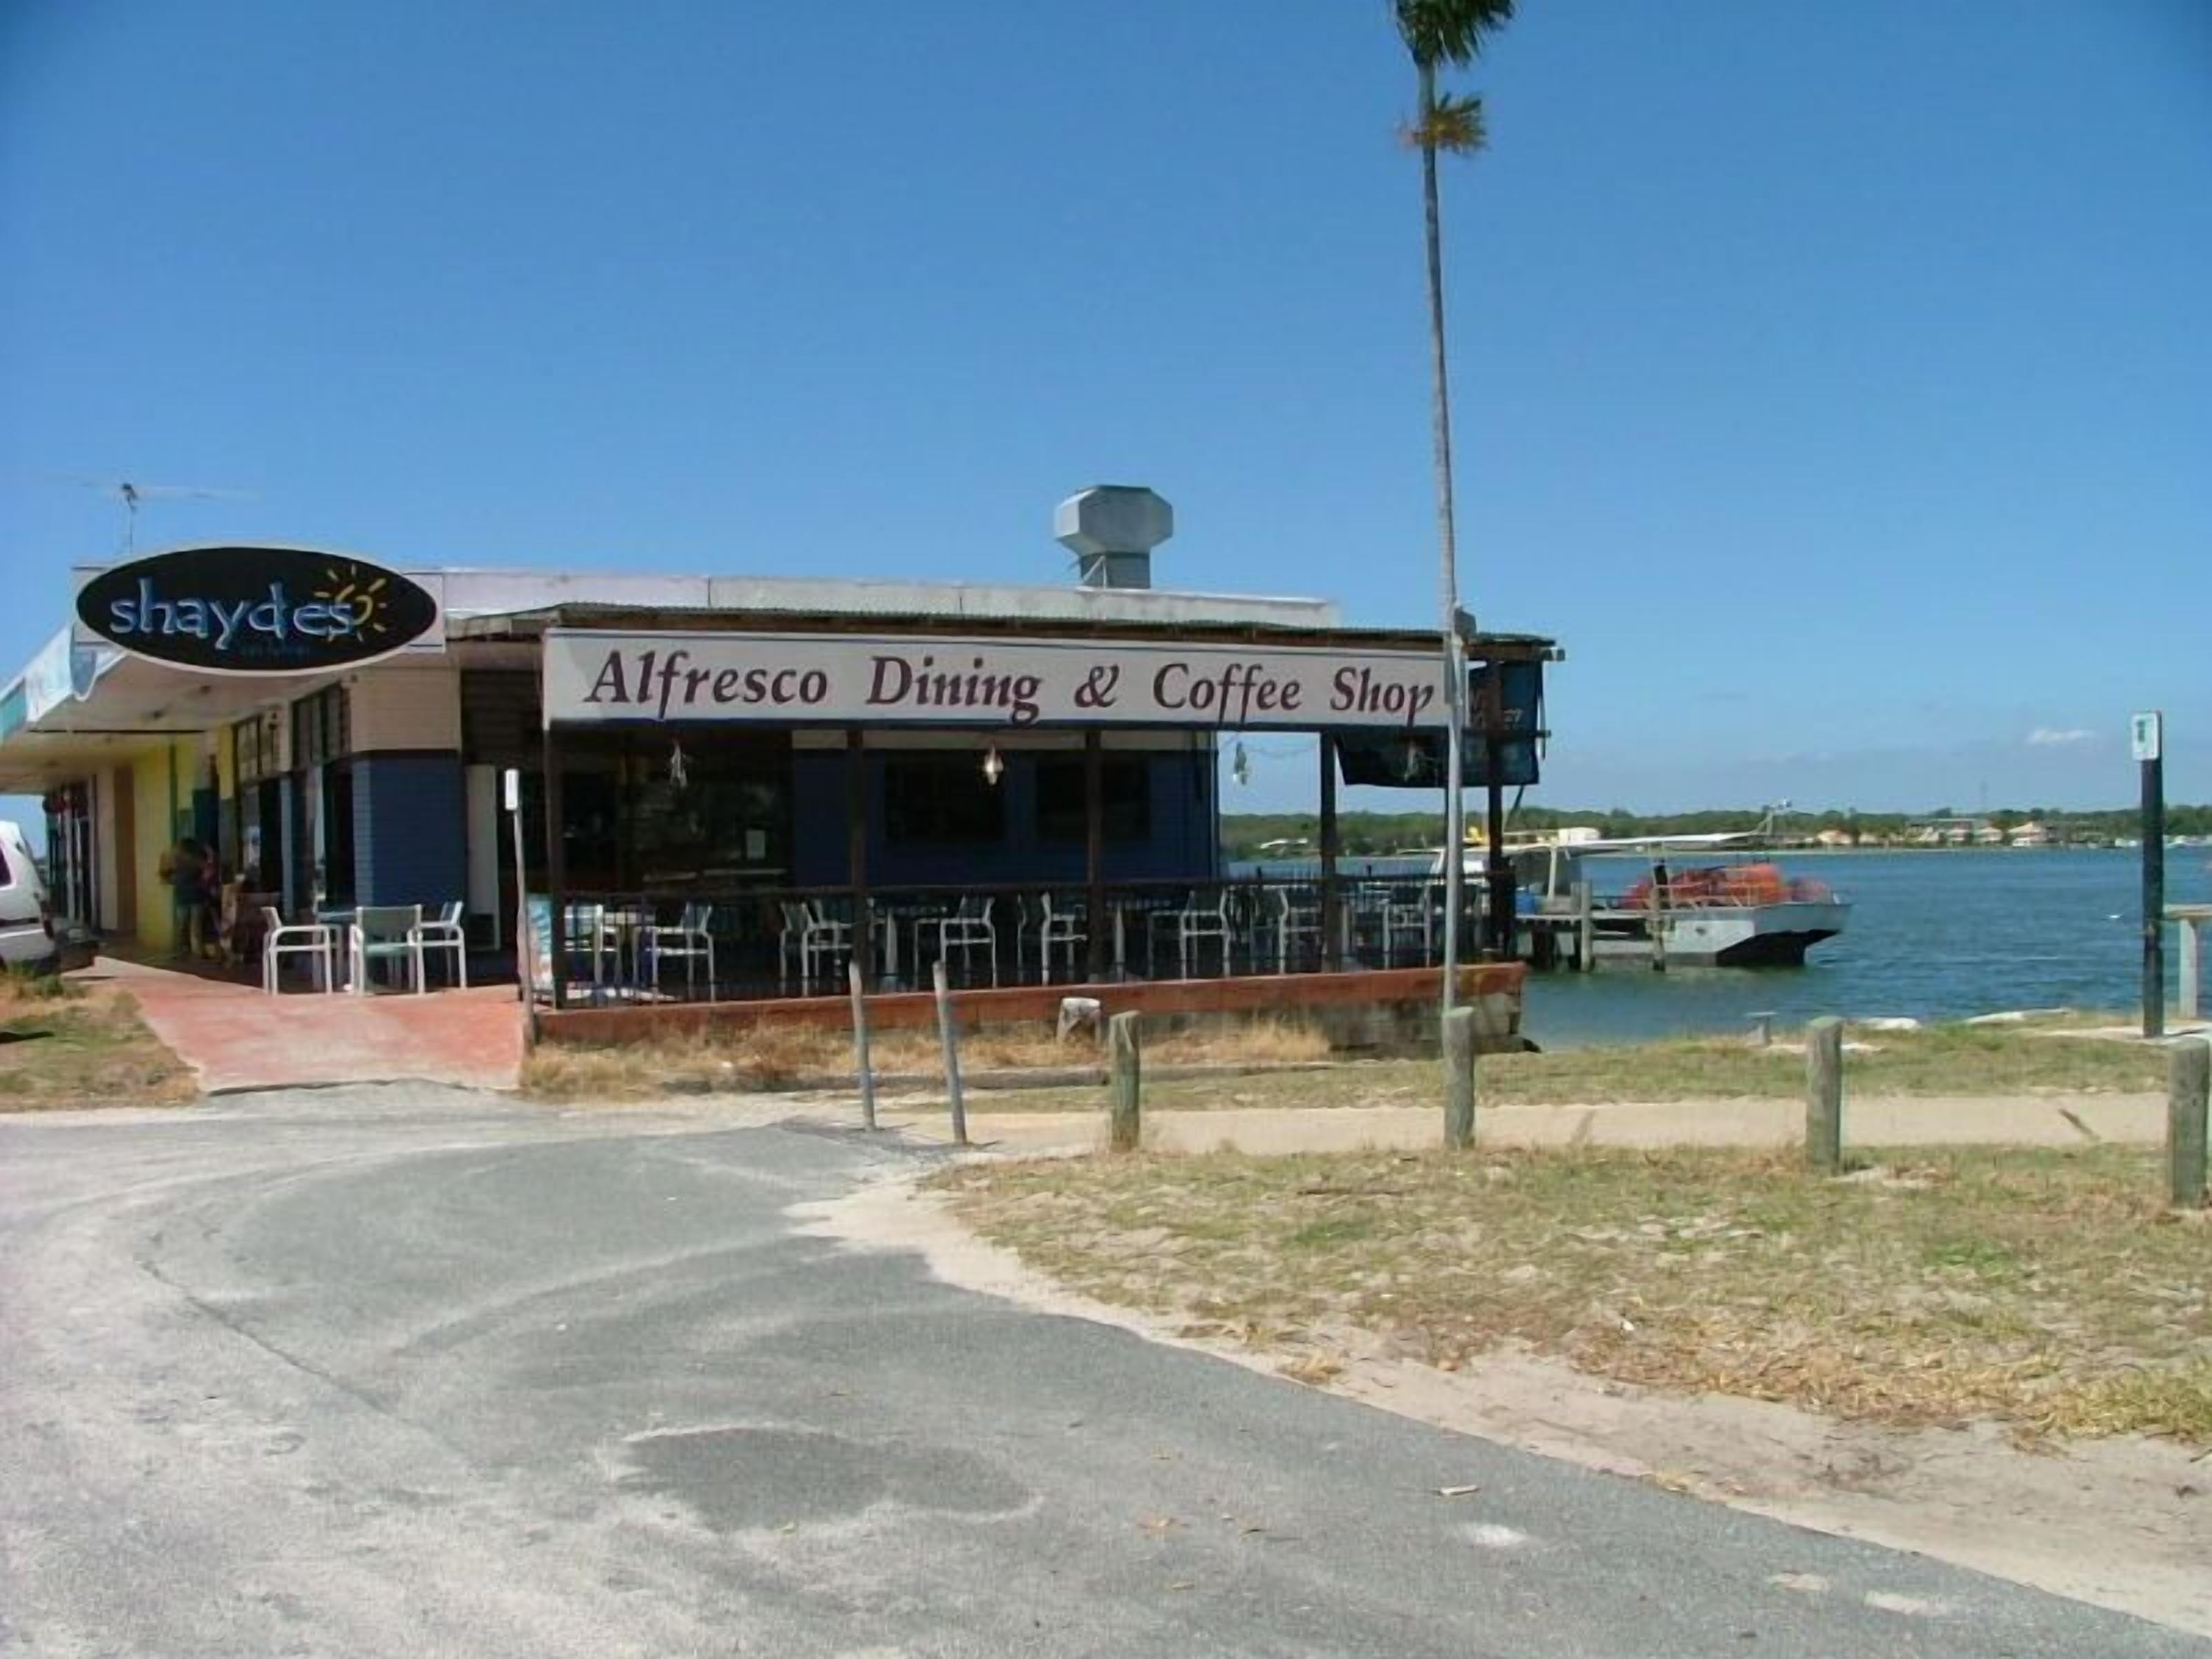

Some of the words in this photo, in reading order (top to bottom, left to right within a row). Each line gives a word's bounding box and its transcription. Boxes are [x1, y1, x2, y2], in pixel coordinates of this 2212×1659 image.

[109, 577, 352, 650] shaydes
[583, 648, 828, 721] Alfresco
[865, 655, 1042, 725] Dining
[1074, 664, 1120, 708] &
[1153, 662, 1302, 727] Coffee
[1330, 666, 1434, 729] Shop
